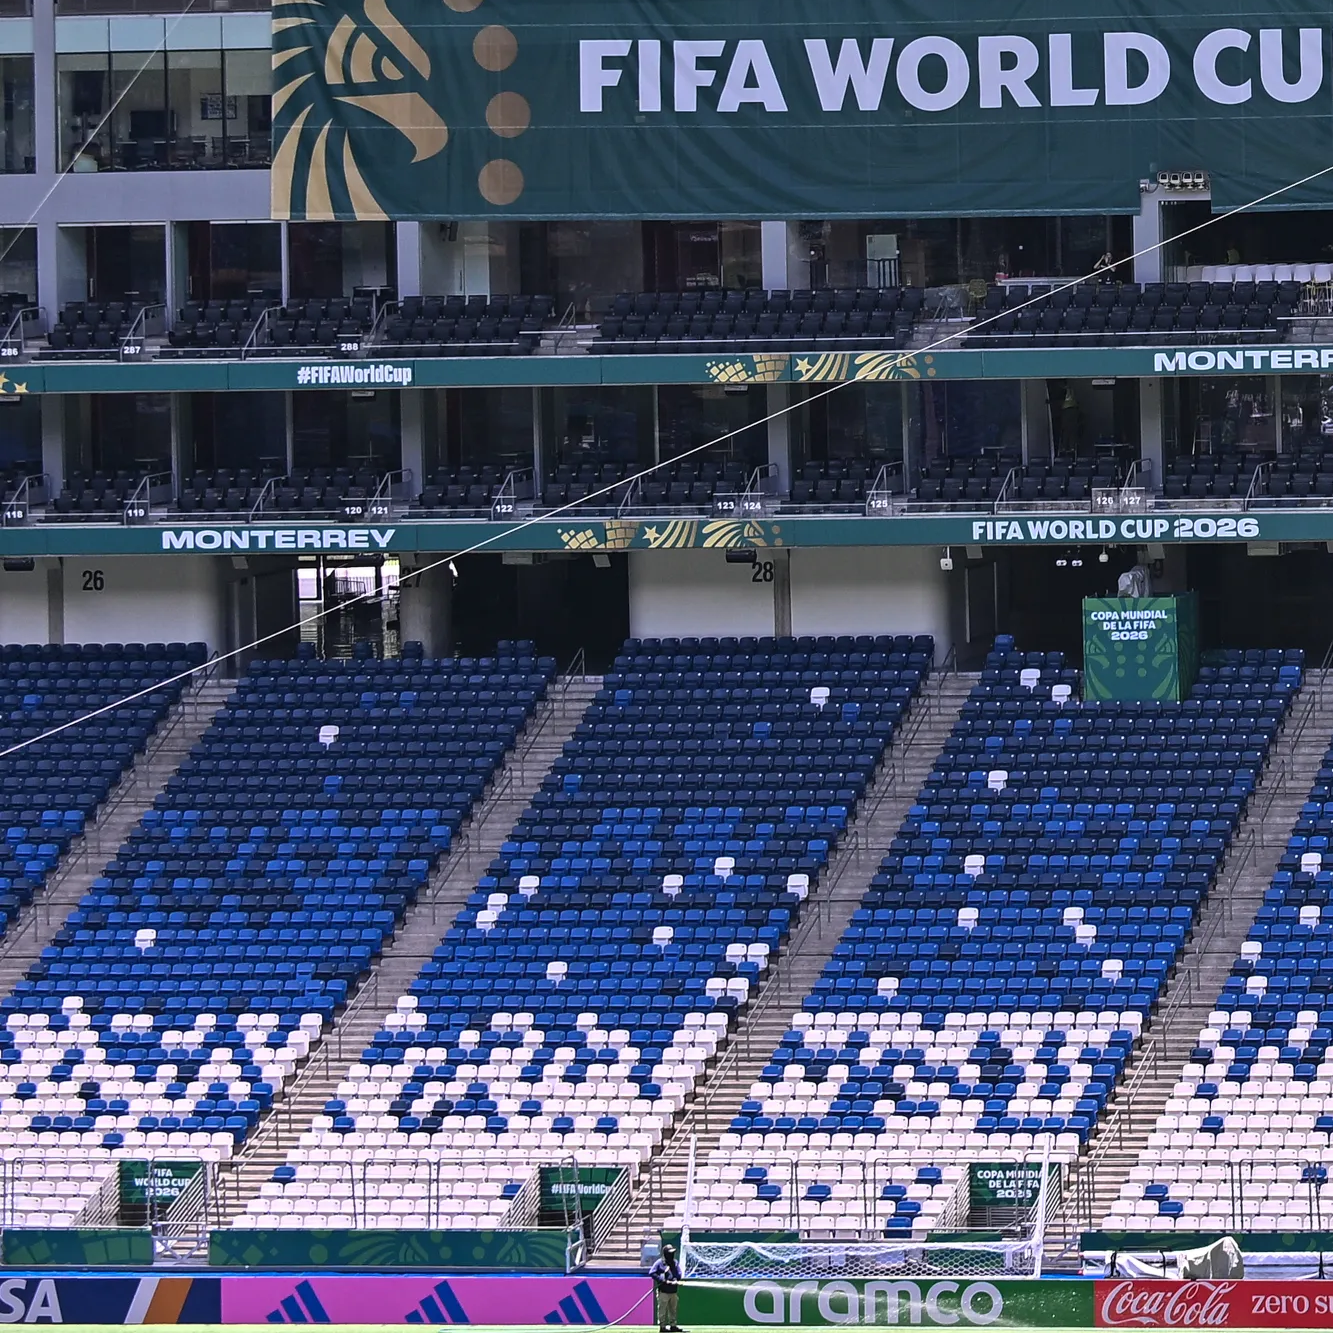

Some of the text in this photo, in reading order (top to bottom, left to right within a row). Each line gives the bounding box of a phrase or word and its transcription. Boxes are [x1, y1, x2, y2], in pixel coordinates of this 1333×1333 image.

[579, 37, 788, 113] FIFA
[805, 31, 1171, 111] WORLD
[124, 346, 141, 354] 287
[341, 342, 358, 351] 288
[1, 348, 18, 357] 286
[297, 362, 412, 387] #FIFAWorldCup
[717, 501, 734, 509] 123
[870, 499, 888, 507] 125
[1097, 496, 1113, 505] 126
[1123, 496, 1140, 505] 127
[496, 504, 513, 512] 122
[744, 501, 761, 510] 124
[6, 510, 23, 519] 118
[128, 509, 145, 517] 119
[972, 517, 1260, 540] FIFA WORLD CUP 2026
[161, 528, 396, 551] MONTERREY
[752, 561, 775, 583] 28
[82, 570, 104, 592] 26
[1091, 610, 1167, 621] COPA MUNDIAL
[1103, 620, 1156, 631] DE LA FIFA
[1111, 631, 1148, 640] 2026
[977, 1170, 1042, 1179] COPA MUNDIA
[989, 1180, 1039, 1188] DE LA FFA
[743, 1280, 1003, 1325] aramco
[1101, 1281, 1238, 1326] Coca-Cola
[1252, 1294, 1310, 1315] zero
